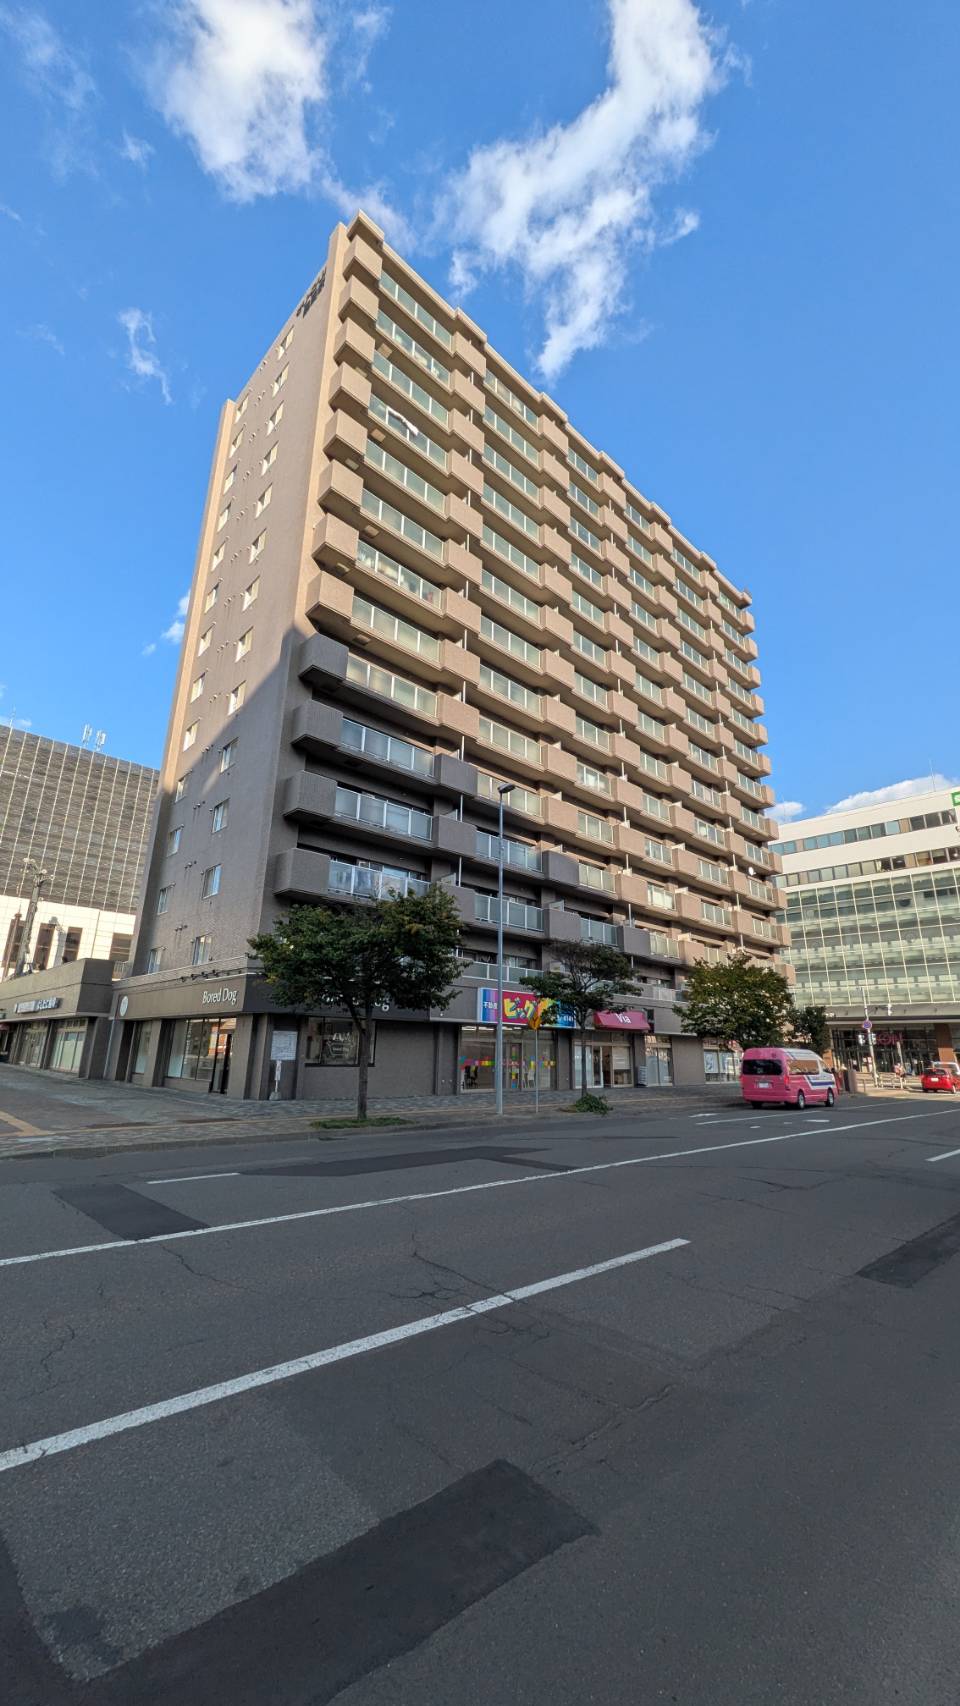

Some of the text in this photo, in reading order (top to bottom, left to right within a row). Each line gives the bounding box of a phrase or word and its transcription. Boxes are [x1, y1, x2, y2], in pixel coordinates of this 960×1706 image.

[202, 987, 237, 1005] Bored Dog
[615, 1012, 632, 1024] Via
